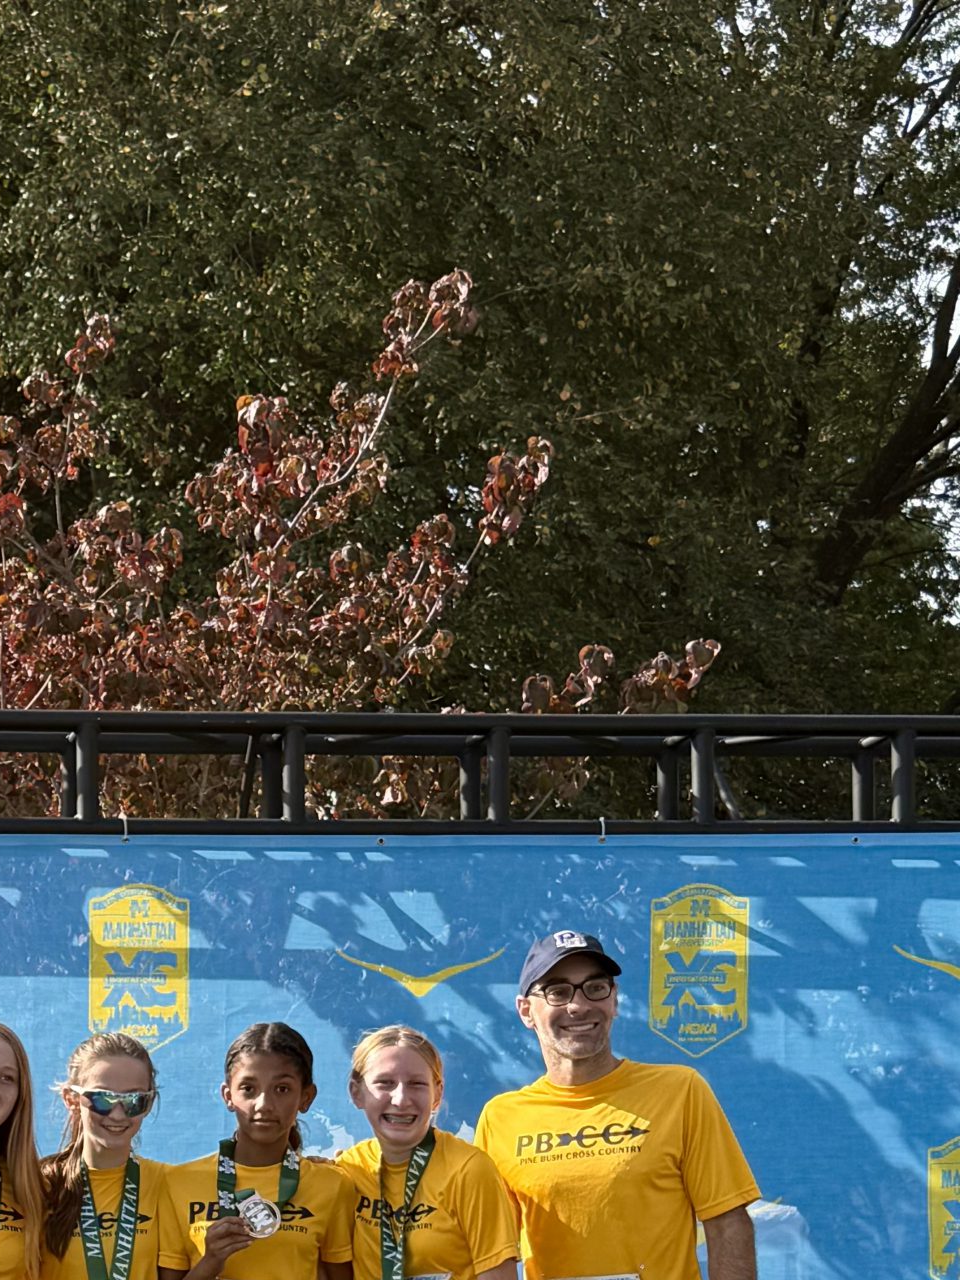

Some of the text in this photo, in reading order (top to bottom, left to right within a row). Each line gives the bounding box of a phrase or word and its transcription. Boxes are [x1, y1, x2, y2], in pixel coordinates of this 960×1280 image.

[103, 922, 176, 941] MANHATTAN
[664, 921, 736, 939] MANHATTAN
[102, 951, 178, 1007] XC
[662, 951, 737, 1005] XC
[520, 1145, 642, 1165] PINE BUSH CROSS COUNTRY
